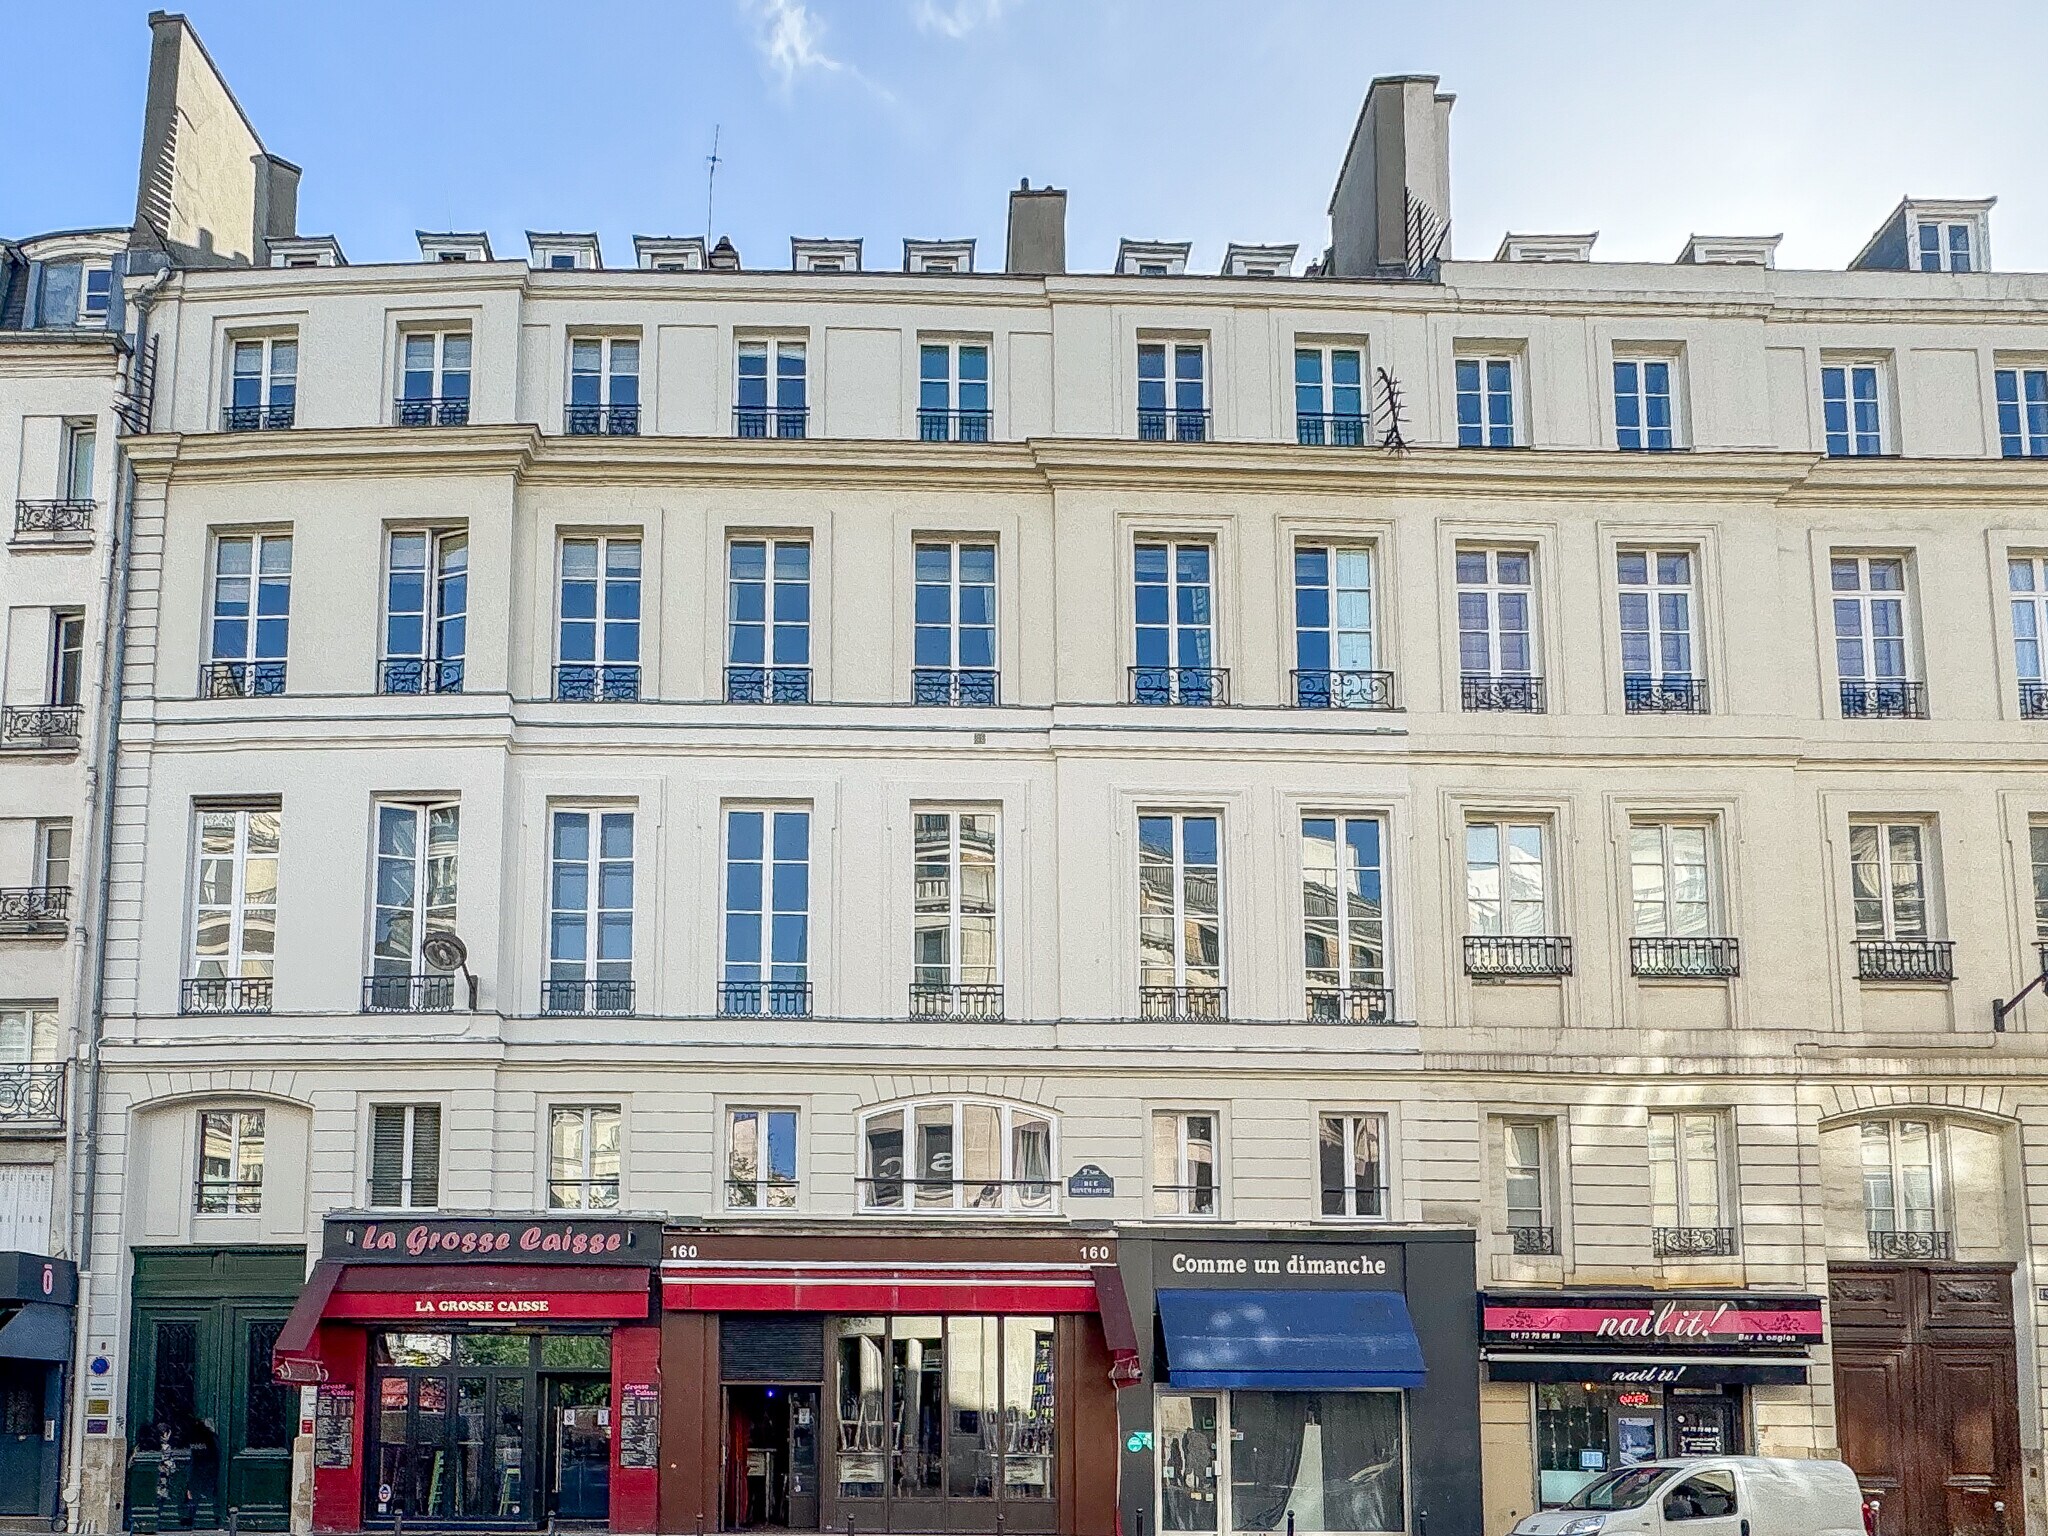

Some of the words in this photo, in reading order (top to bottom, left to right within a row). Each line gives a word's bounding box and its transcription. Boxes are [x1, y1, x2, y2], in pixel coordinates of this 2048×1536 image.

[362, 1225, 397, 1250] La
[405, 1225, 511, 1256] Grosse
[519, 1225, 622, 1255] Caisse
[670, 1244, 698, 1258] 160
[1079, 1245, 1110, 1260] 160
[1172, 1252, 1248, 1274] Comme
[1253, 1258, 1281, 1274] un
[1286, 1254, 1387, 1275] dimanche
[415, 1300, 436, 1313] LA
[438, 1300, 495, 1313] GROSSE
[497, 1300, 550, 1313] CAISSE
[1596, 1300, 1676, 1338] nail
[1673, 1302, 1728, 1338] it!
[1738, 1333, 1754, 1341] Bar
[1765, 1334, 1797, 1344] ongles
[1611, 1366, 1656, 1382] nail
[1656, 1366, 1687, 1382] it!
